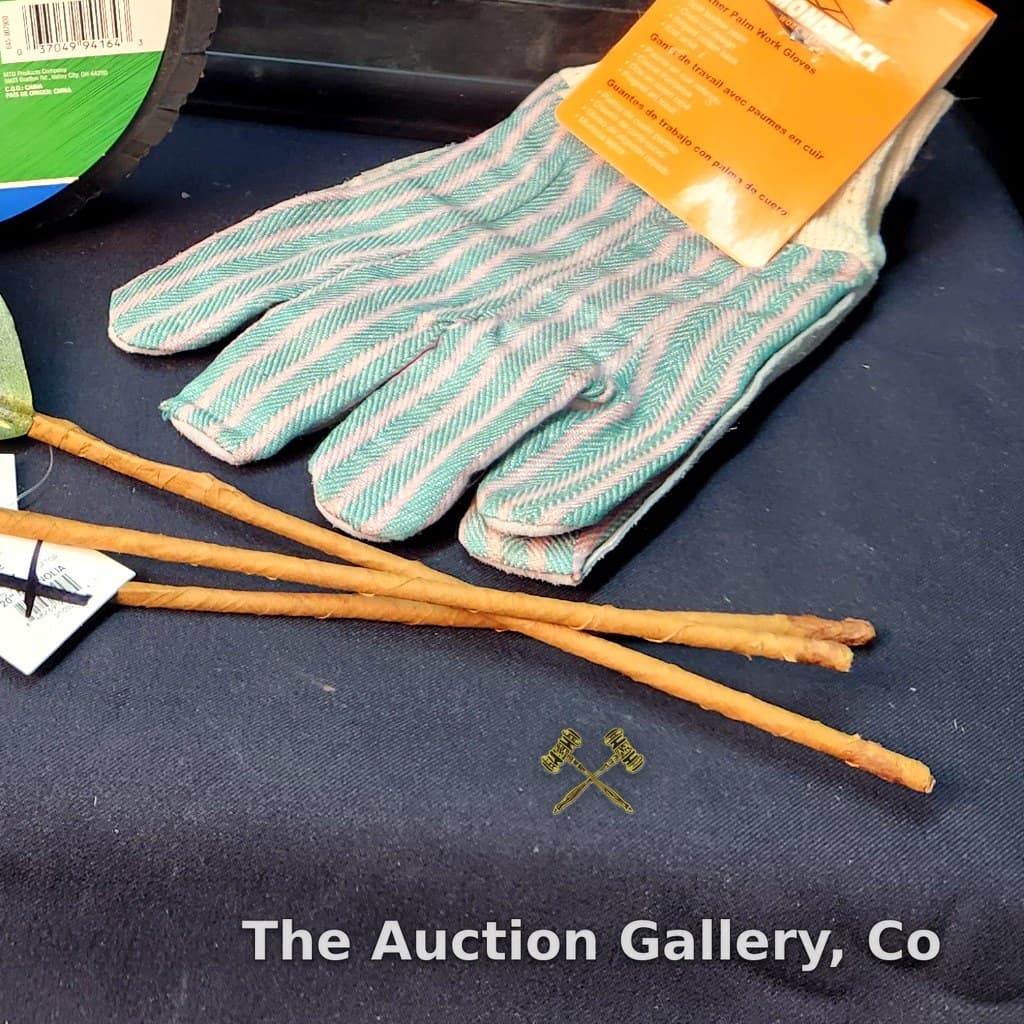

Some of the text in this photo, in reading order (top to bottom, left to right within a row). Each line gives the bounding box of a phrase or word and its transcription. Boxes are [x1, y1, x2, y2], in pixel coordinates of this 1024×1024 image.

[17, 48, 23, 56] 0
[40, 42, 76, 54] 37049
[84, 38, 121, 50] 94164
[729, 9, 755, 32] Palm
[756, 27, 782, 51] Work
[782, 47, 817, 75] Gloves
[606, 79, 645, 110] Guantes
[645, 108, 658, 121] de
[658, 118, 692, 148] trabajo
[693, 145, 712, 161] con
[744, 183, 758, 195] de
[758, 193, 789, 216] cuero
[678, 53, 691, 66] de
[692, 63, 724, 89] travail
[722, 86, 748, 106] avec
[746, 104, 788, 136] paumes
[788, 133, 802, 146] en
[803, 144, 825, 161] cuir
